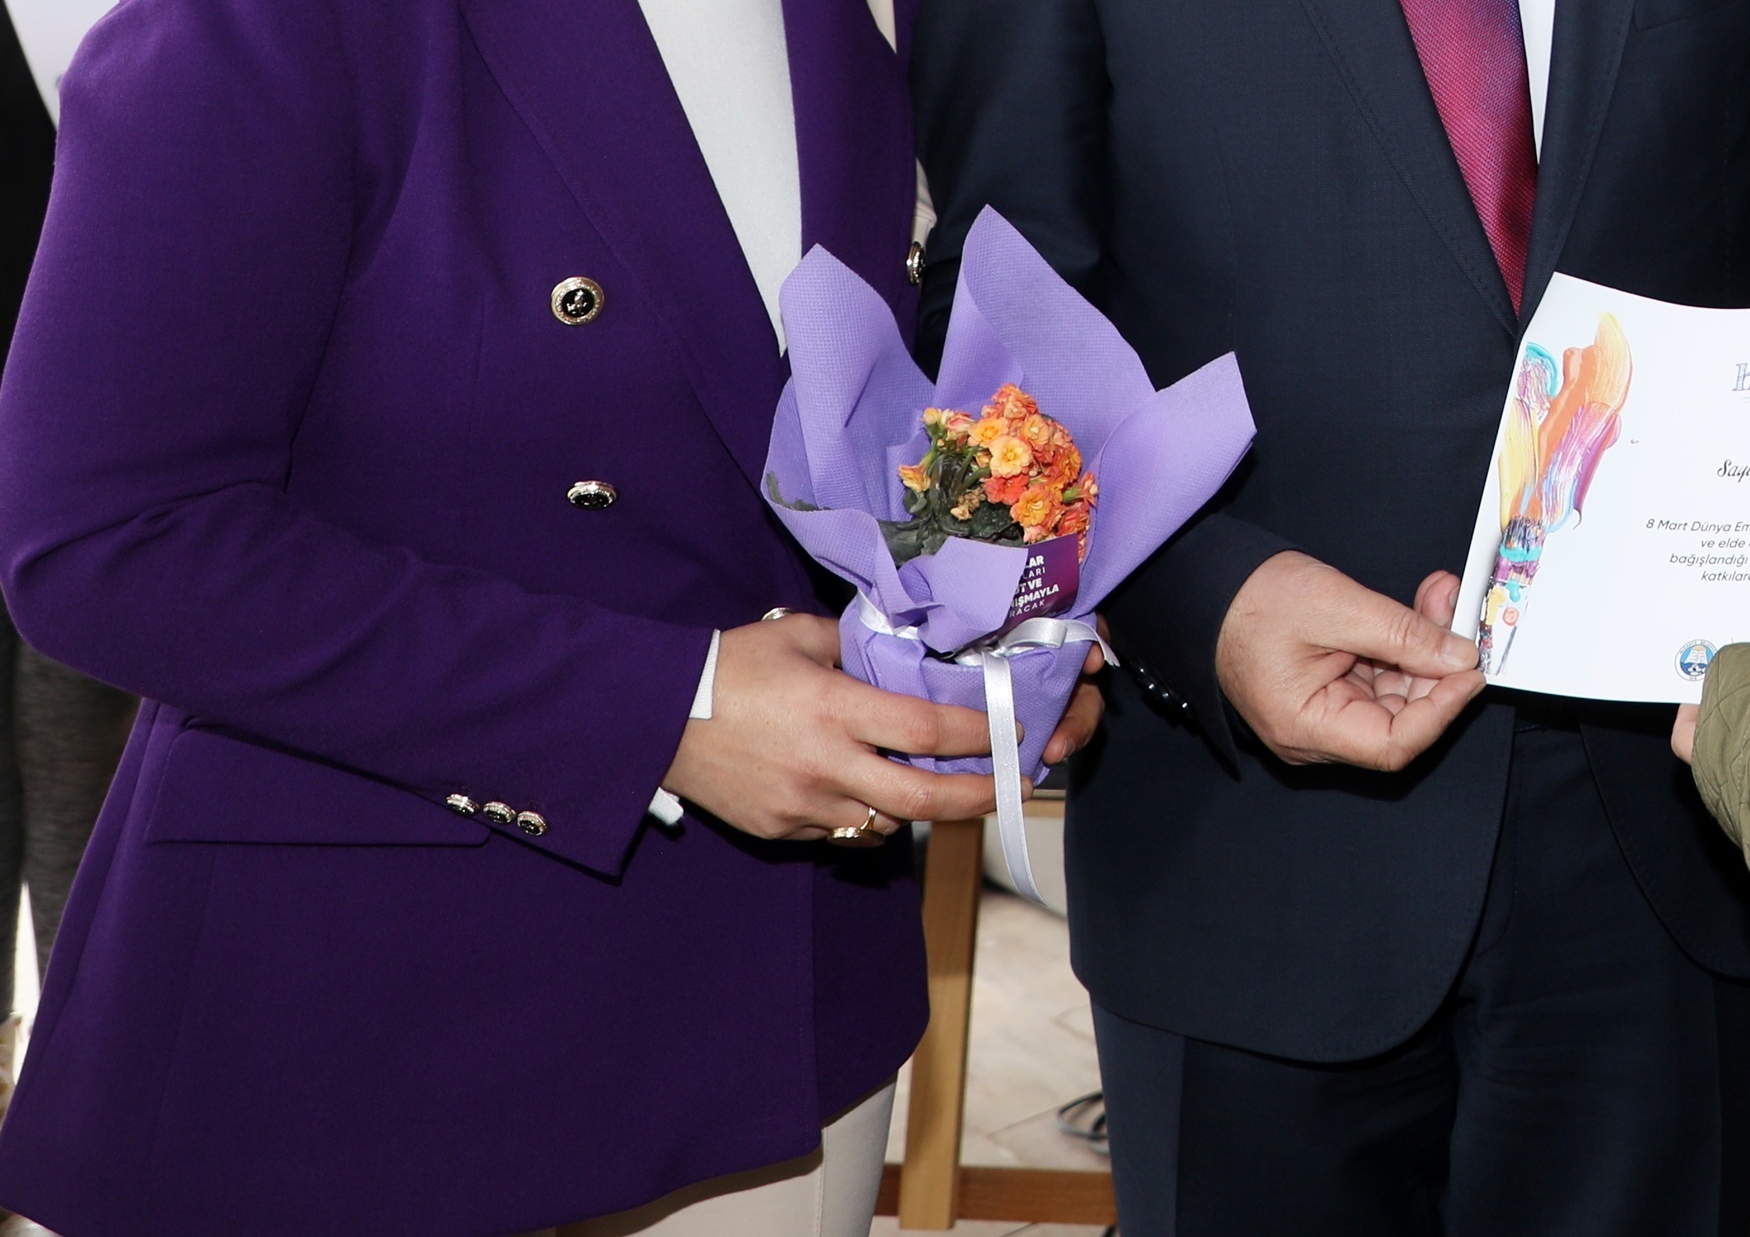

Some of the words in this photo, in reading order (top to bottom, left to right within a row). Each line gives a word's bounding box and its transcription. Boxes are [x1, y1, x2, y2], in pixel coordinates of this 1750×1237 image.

[1646, 518, 1655, 529] 8
[1657, 519, 1688, 531] Mart
[1691, 521, 1732, 534] Dünya
[1701, 540, 1715, 548] ve
[1718, 538, 1746, 548] elde
[1669, 553, 1748, 567] bağışlandığı
[1027, 578, 1043, 590] VE
